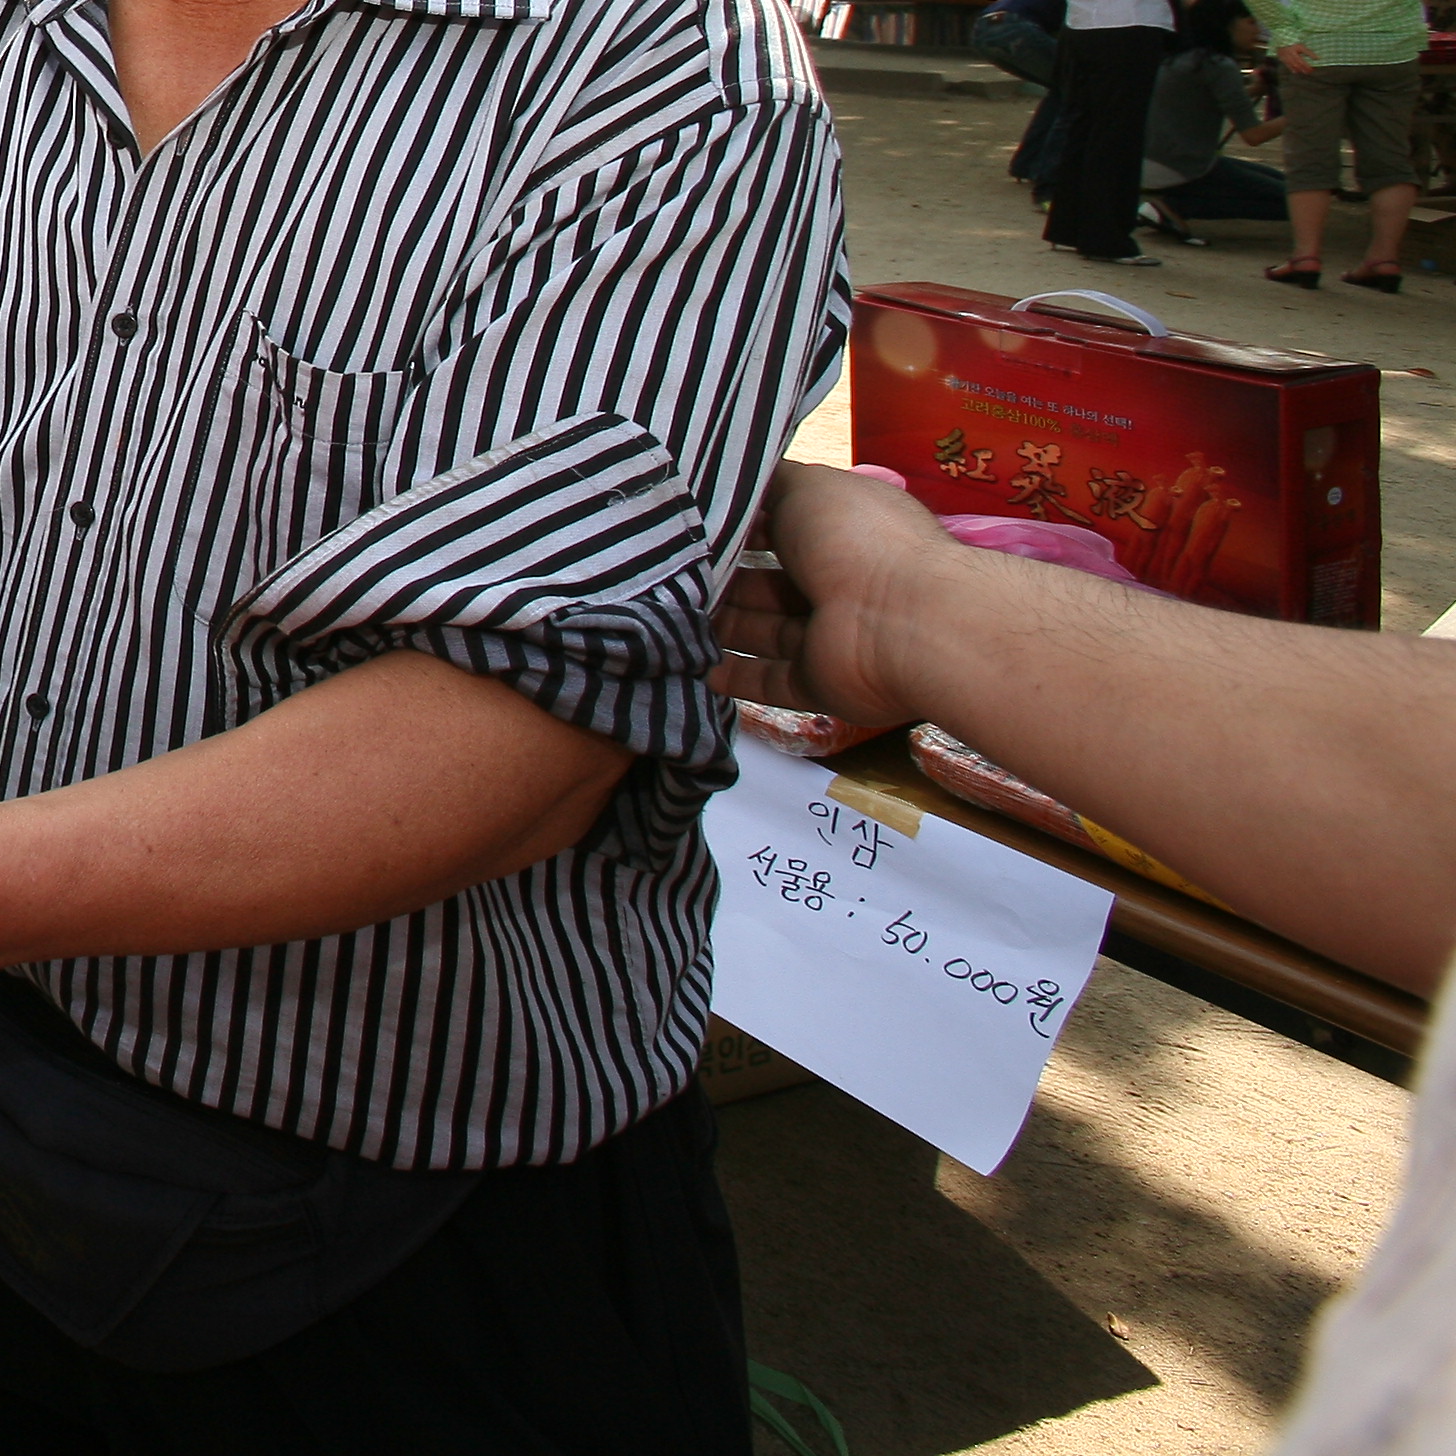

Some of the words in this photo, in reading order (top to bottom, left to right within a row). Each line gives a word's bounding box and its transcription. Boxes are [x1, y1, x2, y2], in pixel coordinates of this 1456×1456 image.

[1063, 405, 1098, 422] 하나의
[807, 799, 895, 870] 인삼
[747, 846, 836, 912] 선물용
